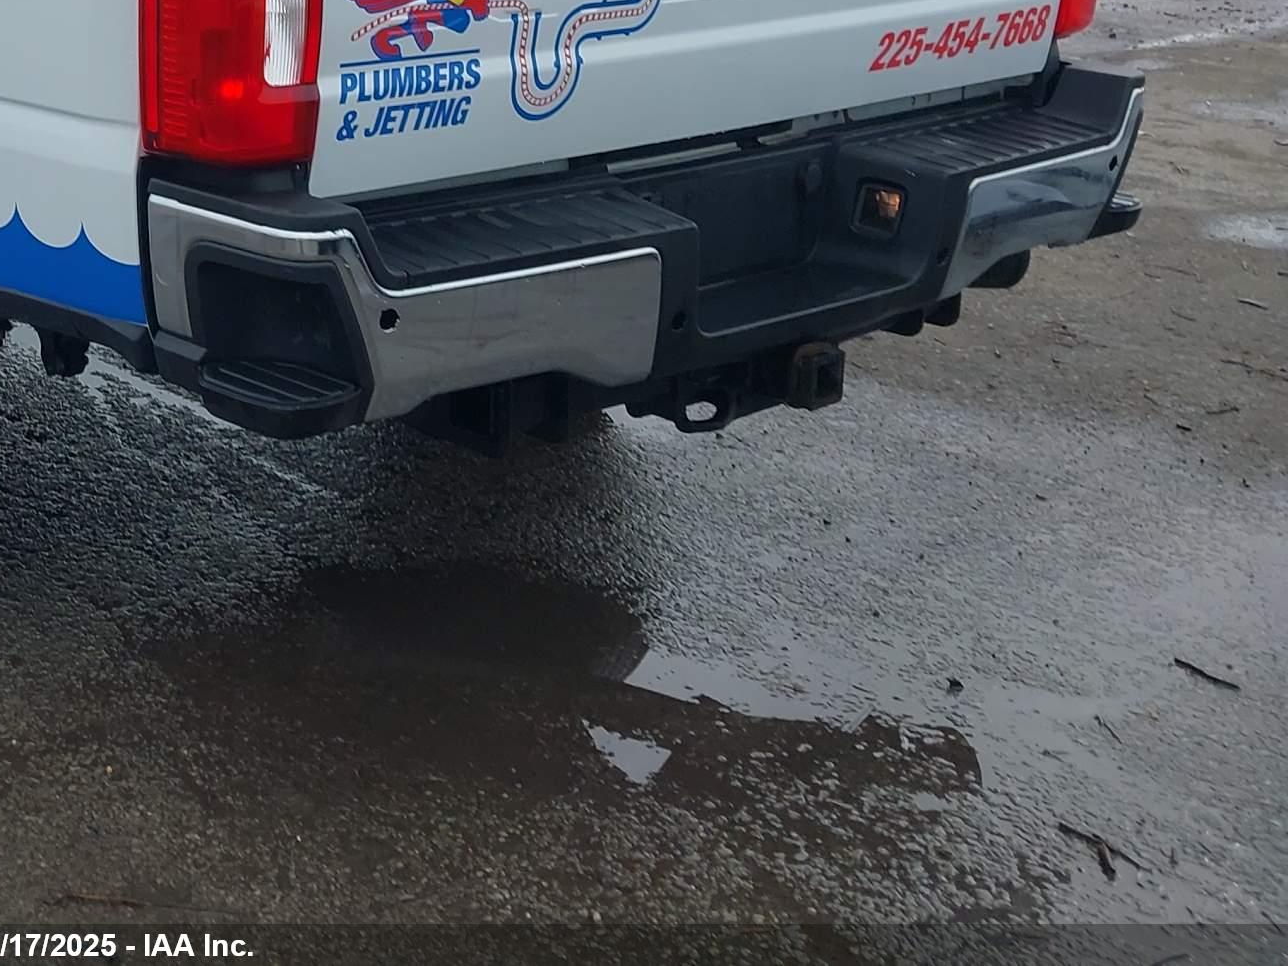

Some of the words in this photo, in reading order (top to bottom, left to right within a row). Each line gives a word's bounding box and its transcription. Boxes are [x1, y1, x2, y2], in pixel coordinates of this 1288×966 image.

[869, 4, 1051, 73] 225-454-7668
[339, 58, 481, 105] PLUMBERS
[336, 110, 358, 141] &
[364, 97, 471, 138] JETTING
